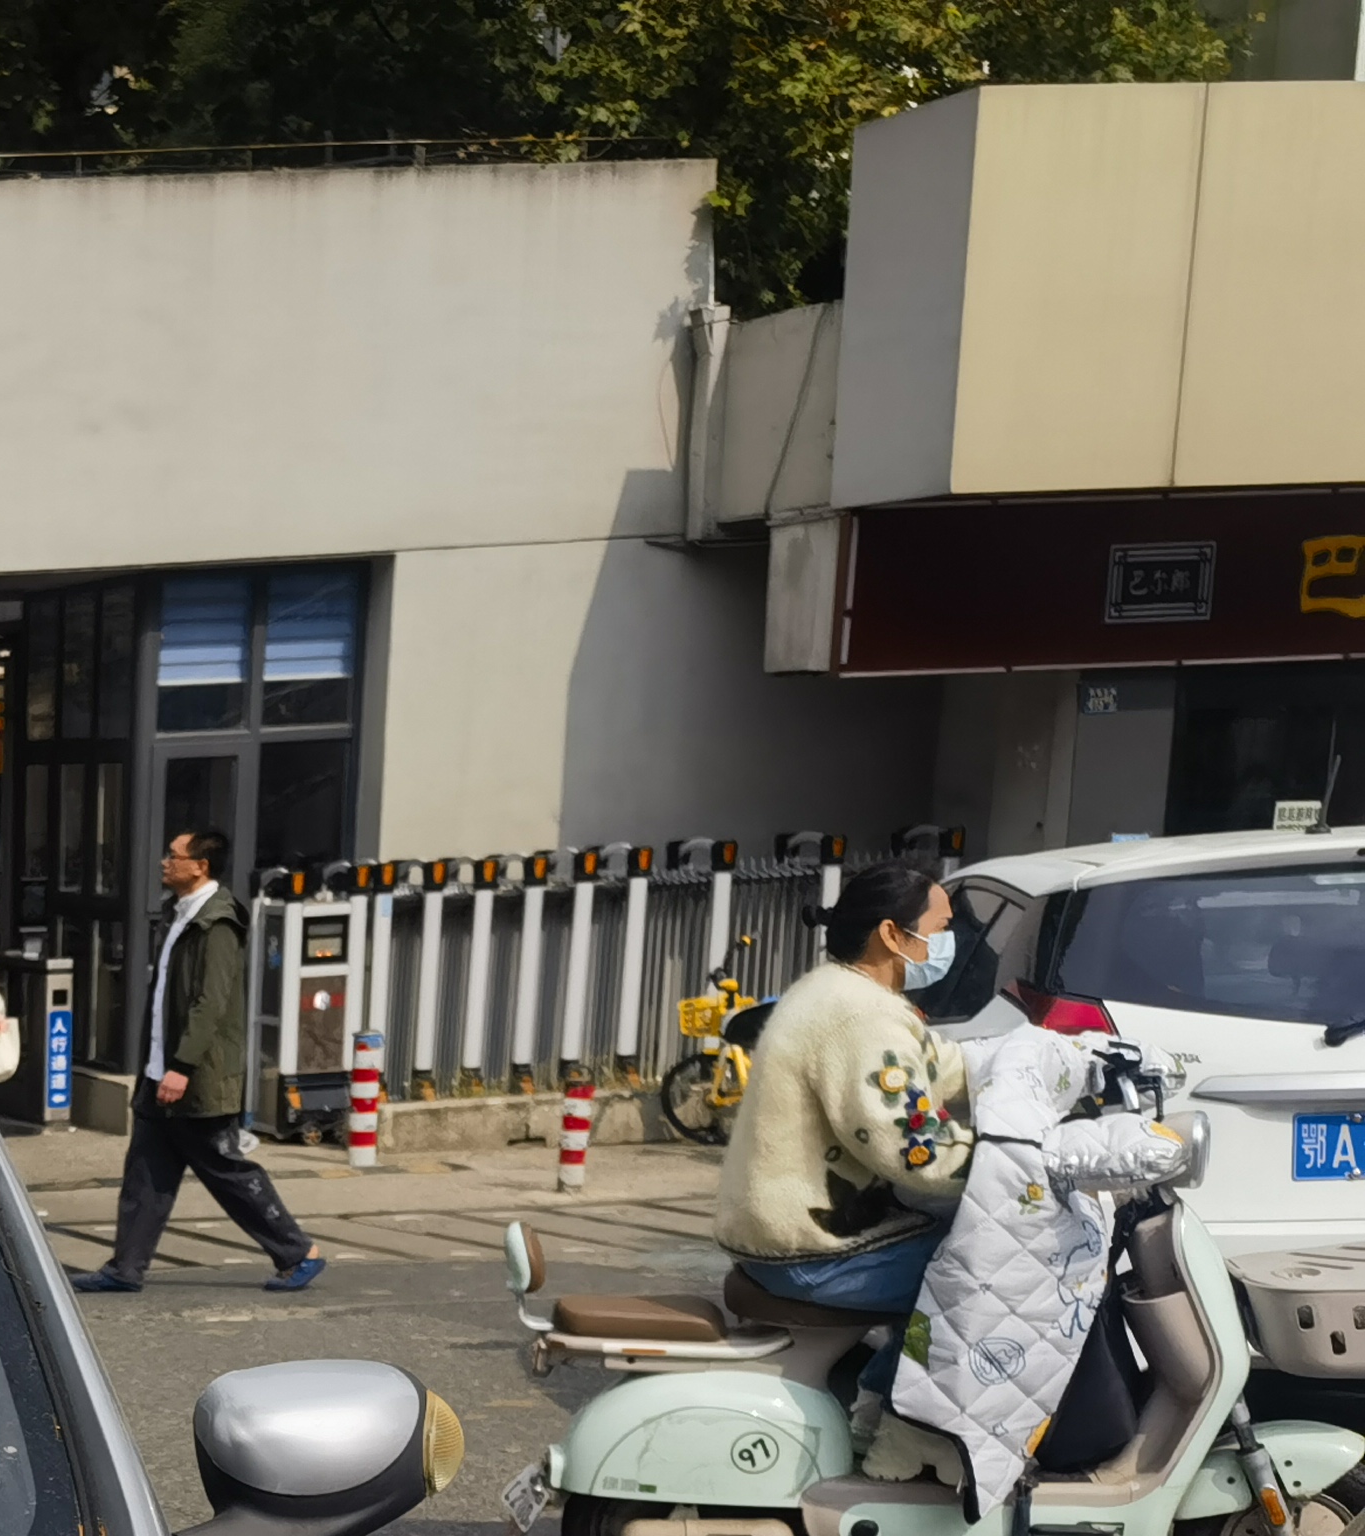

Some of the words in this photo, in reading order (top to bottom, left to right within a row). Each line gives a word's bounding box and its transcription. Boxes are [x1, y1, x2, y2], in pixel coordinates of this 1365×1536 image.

[51, 1017, 68, 1090] 人行通道
[738, 1438, 771, 1468] 97
